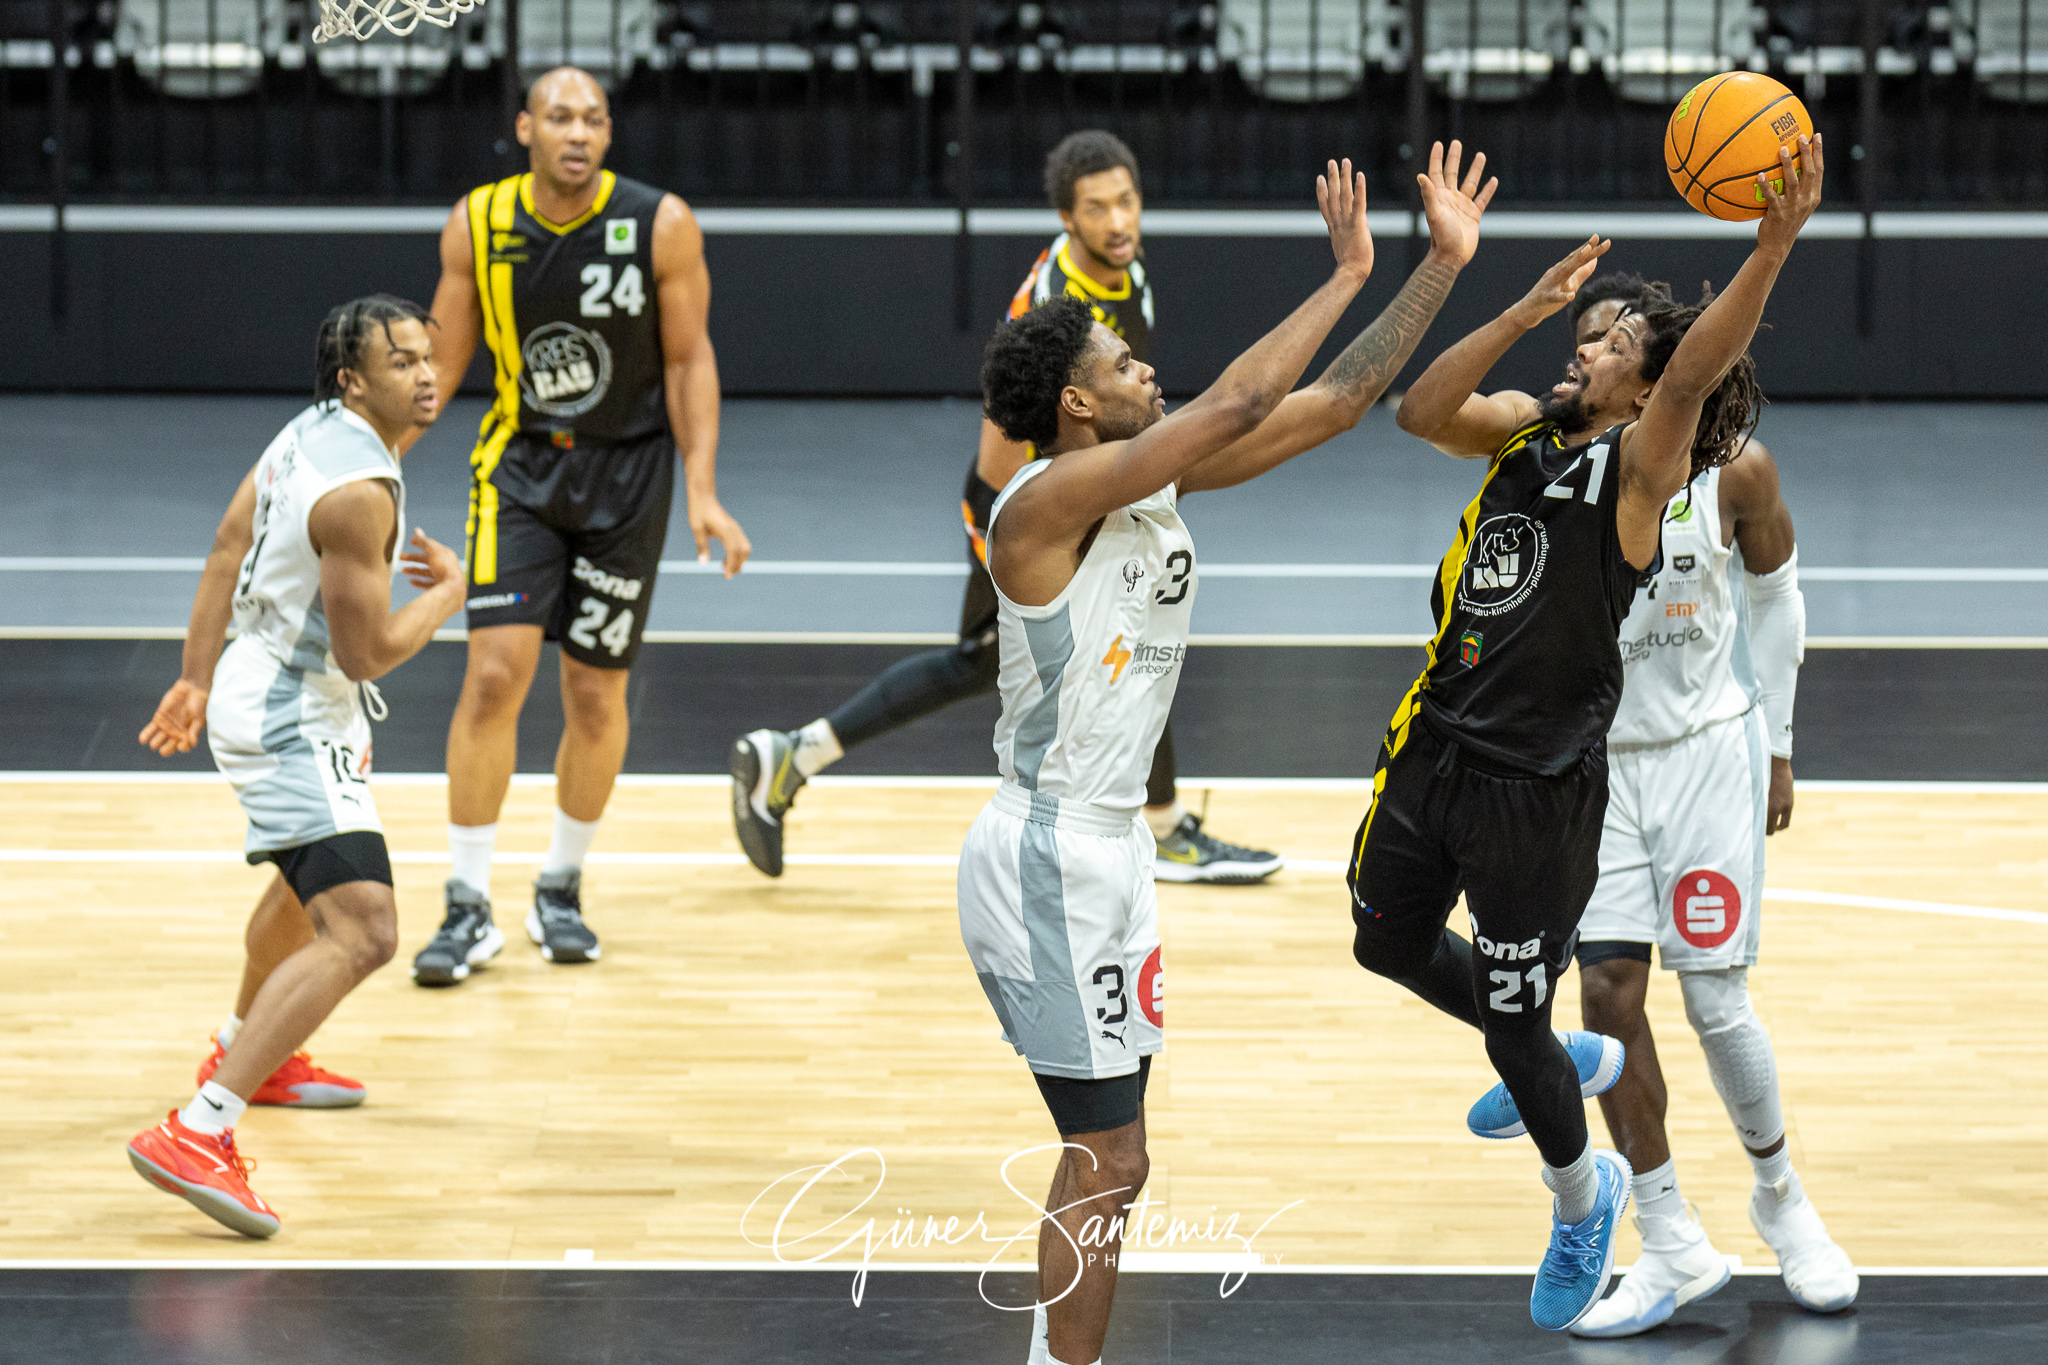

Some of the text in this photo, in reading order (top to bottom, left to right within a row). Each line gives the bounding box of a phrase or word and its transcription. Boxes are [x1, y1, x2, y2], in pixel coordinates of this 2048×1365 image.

[1770, 111, 1797, 136] FIBA
[580, 263, 645, 317] 24
[1543, 443, 1610, 505] 21
[1155, 550, 1192, 605] 3
[568, 596, 635, 658] 24
[1092, 964, 1128, 1025] 3
[1489, 962, 1548, 1013] 21
